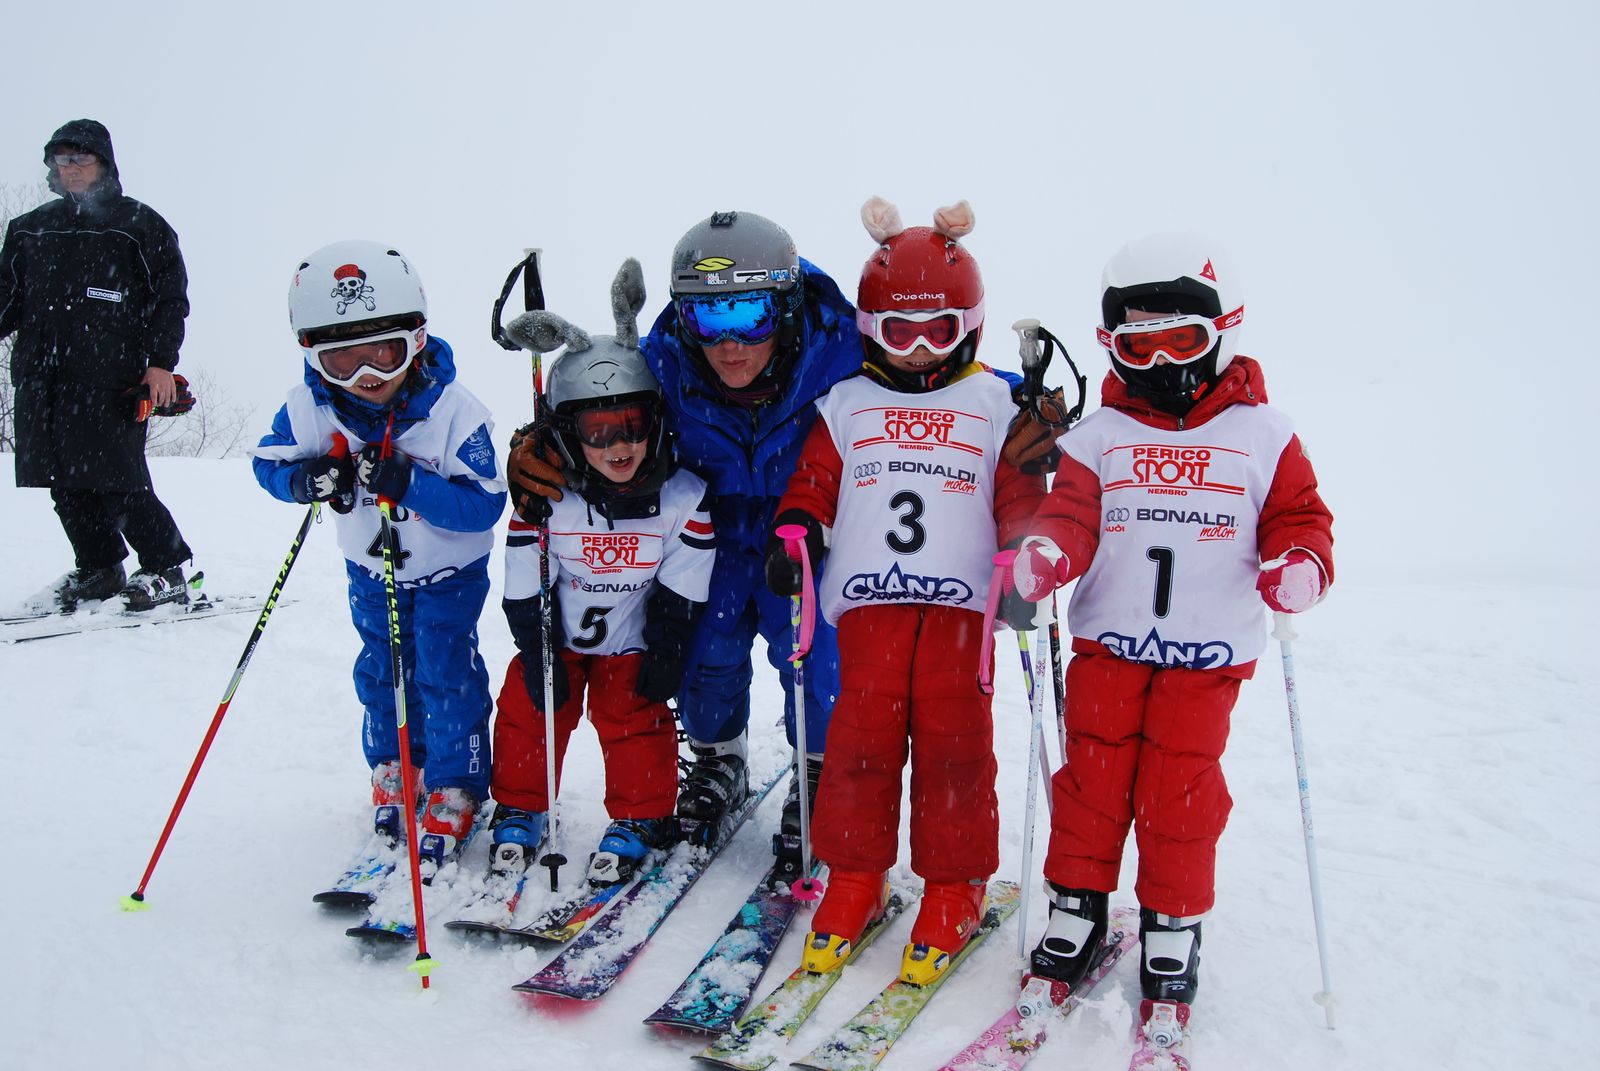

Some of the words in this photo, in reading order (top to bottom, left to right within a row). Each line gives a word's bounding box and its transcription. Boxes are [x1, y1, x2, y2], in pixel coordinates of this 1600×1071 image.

[891, 292, 945, 301] Quechua
[883, 410, 955, 423] PERICO
[884, 419, 954, 444] SPORT
[898, 444, 934, 452] NEMBRO
[1132, 447, 1211, 461] PERICO
[888, 461, 976, 484] BONALDI
[1132, 459, 1210, 487] SPORT
[1147, 488, 1188, 497] NEMBRO
[885, 489, 927, 556] 3
[1136, 508, 1236, 528] BONALDI
[366, 525, 412, 571] 4
[581, 535, 640, 547] PERICO
[582, 545, 639, 566] SPORT
[382, 547, 396, 595] LEKI
[152, 584, 185, 601] LANGE
[1146, 546, 1175, 620] 1
[257, 587, 281, 632] LEKI
[571, 605, 616, 649] 5
